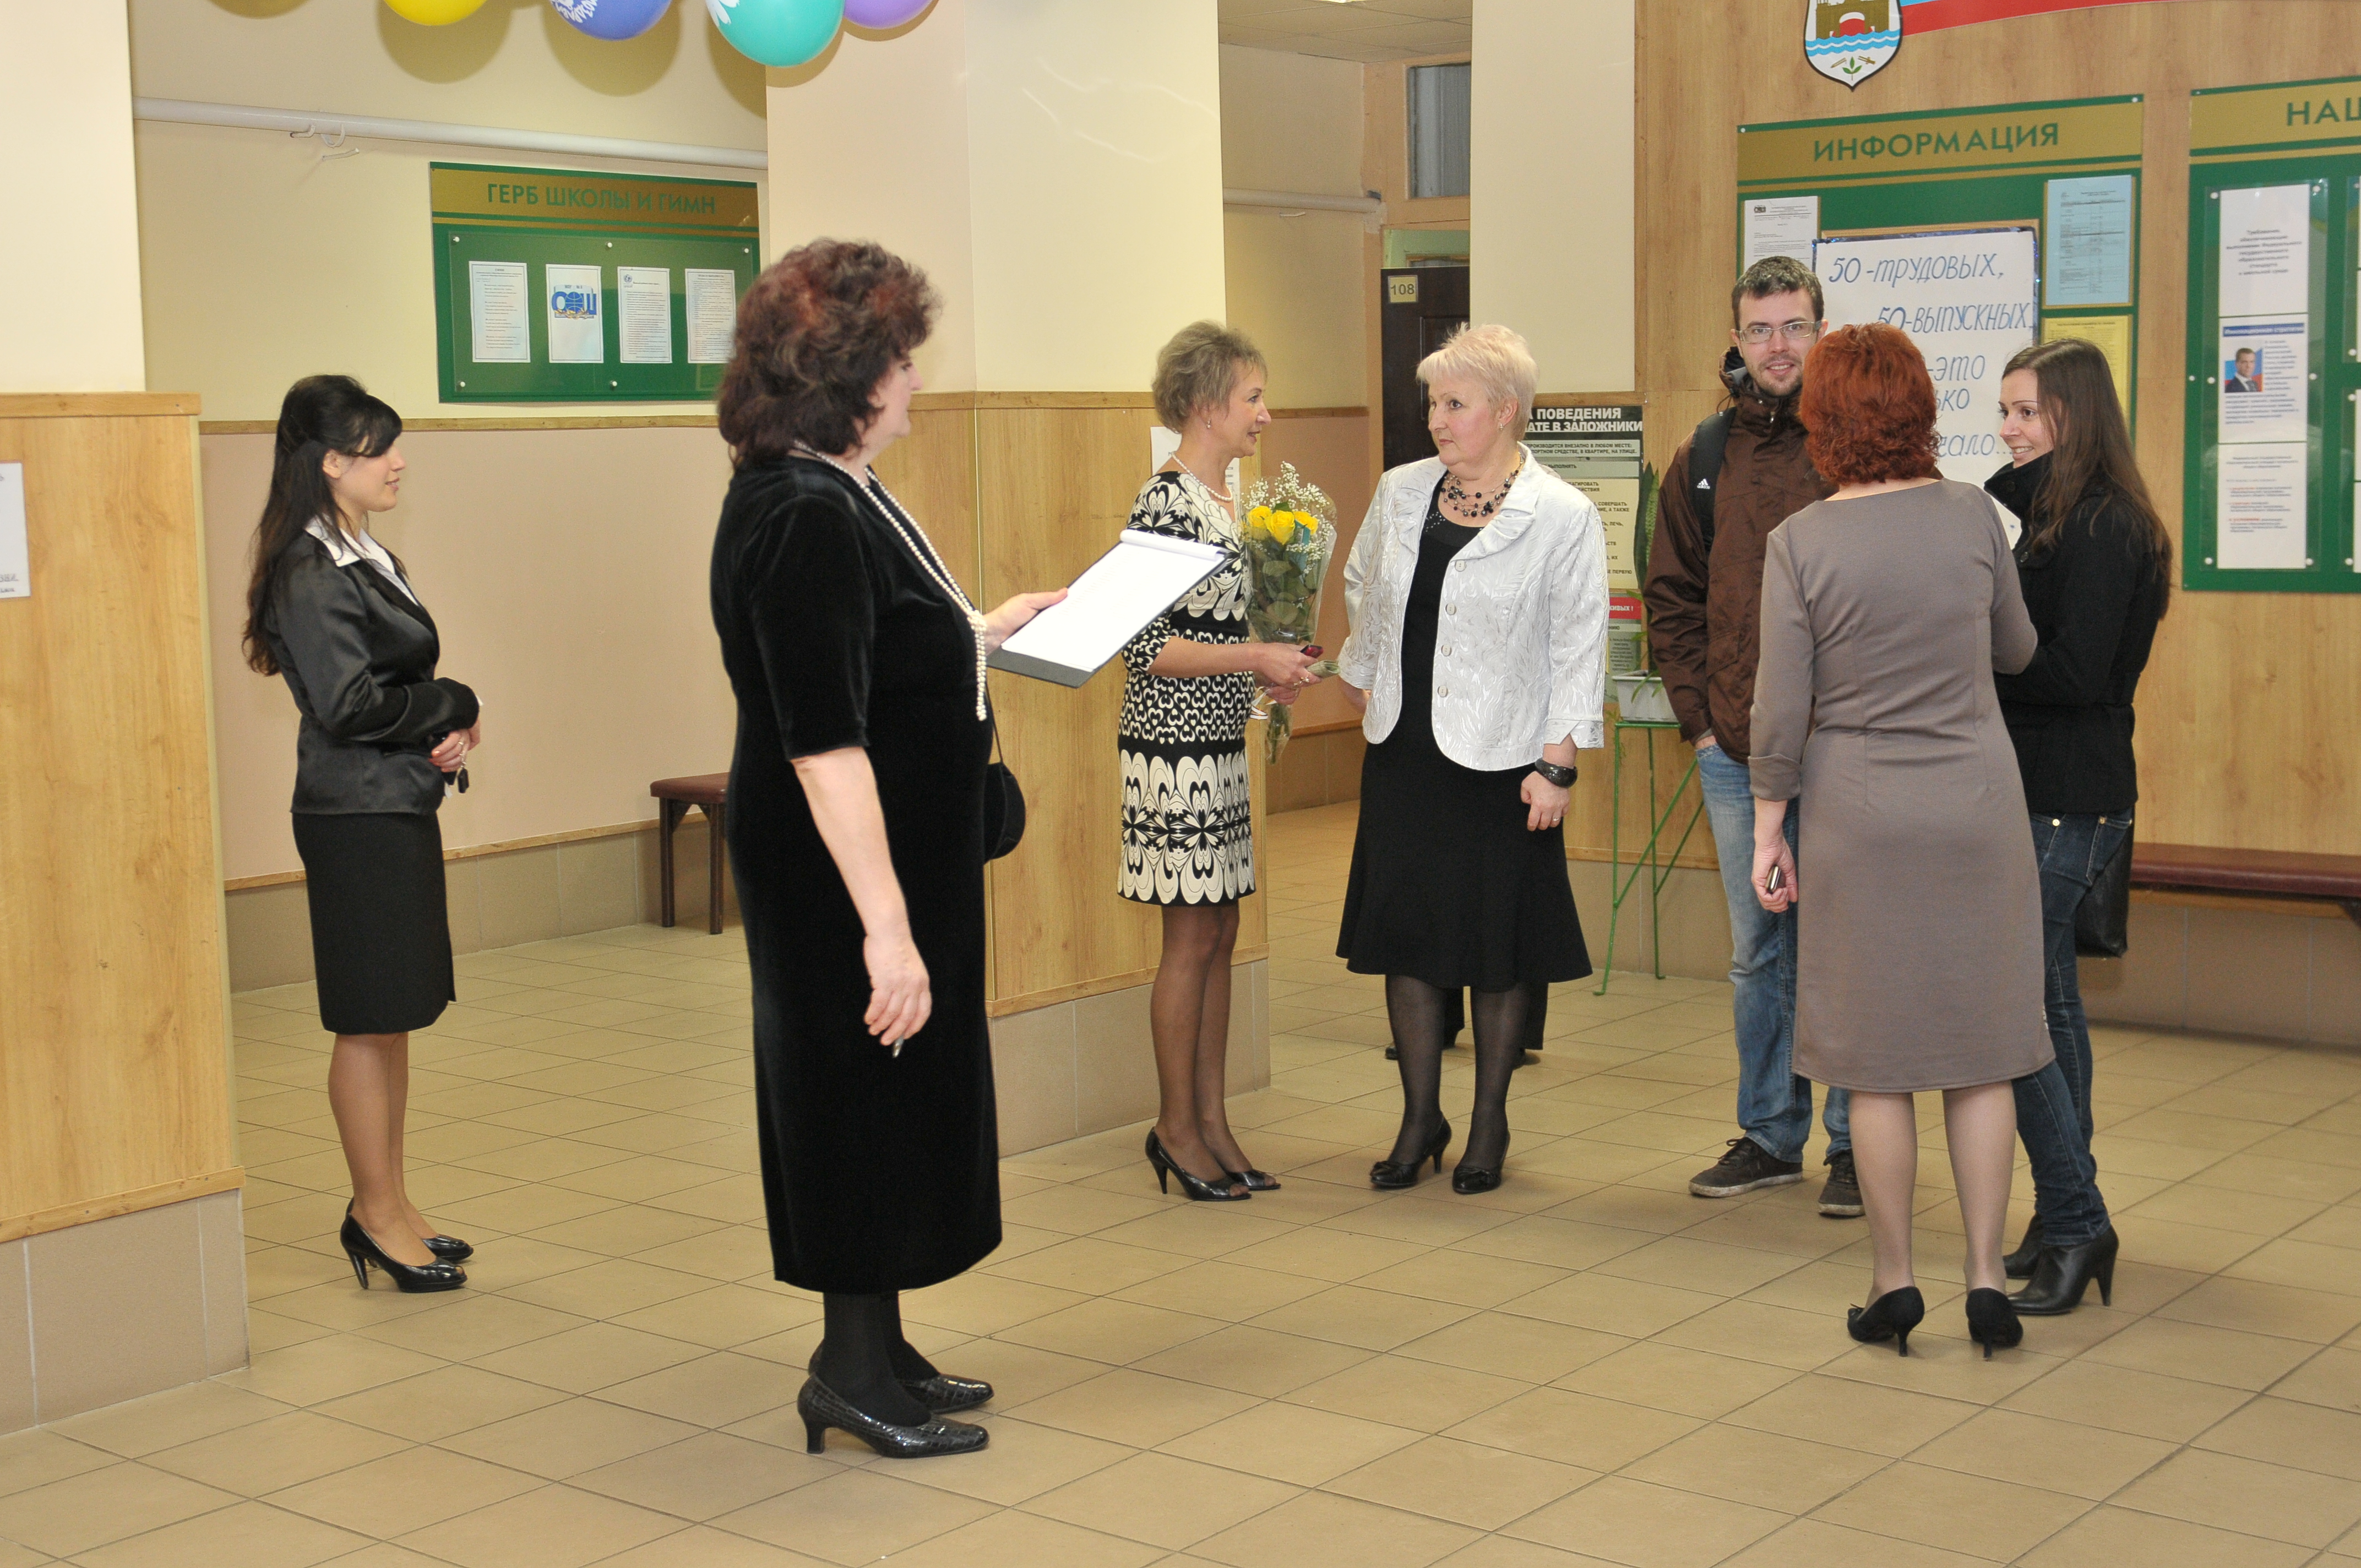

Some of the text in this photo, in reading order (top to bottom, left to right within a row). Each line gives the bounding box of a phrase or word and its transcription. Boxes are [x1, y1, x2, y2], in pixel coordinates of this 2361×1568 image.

[1814, 122, 2058, 162] ИНФОРМАЦИЯ
[488, 183, 716, 215] ГЕРБ ШКОЛЫ И ГИМН
[1390, 284, 1415, 295] 108
[1537, 408, 1621, 421] ПОВЕДЕНИЯ
[1553, 422, 1561, 432] В
[1563, 421, 1643, 432] ЗАЛОЖНИКИ
